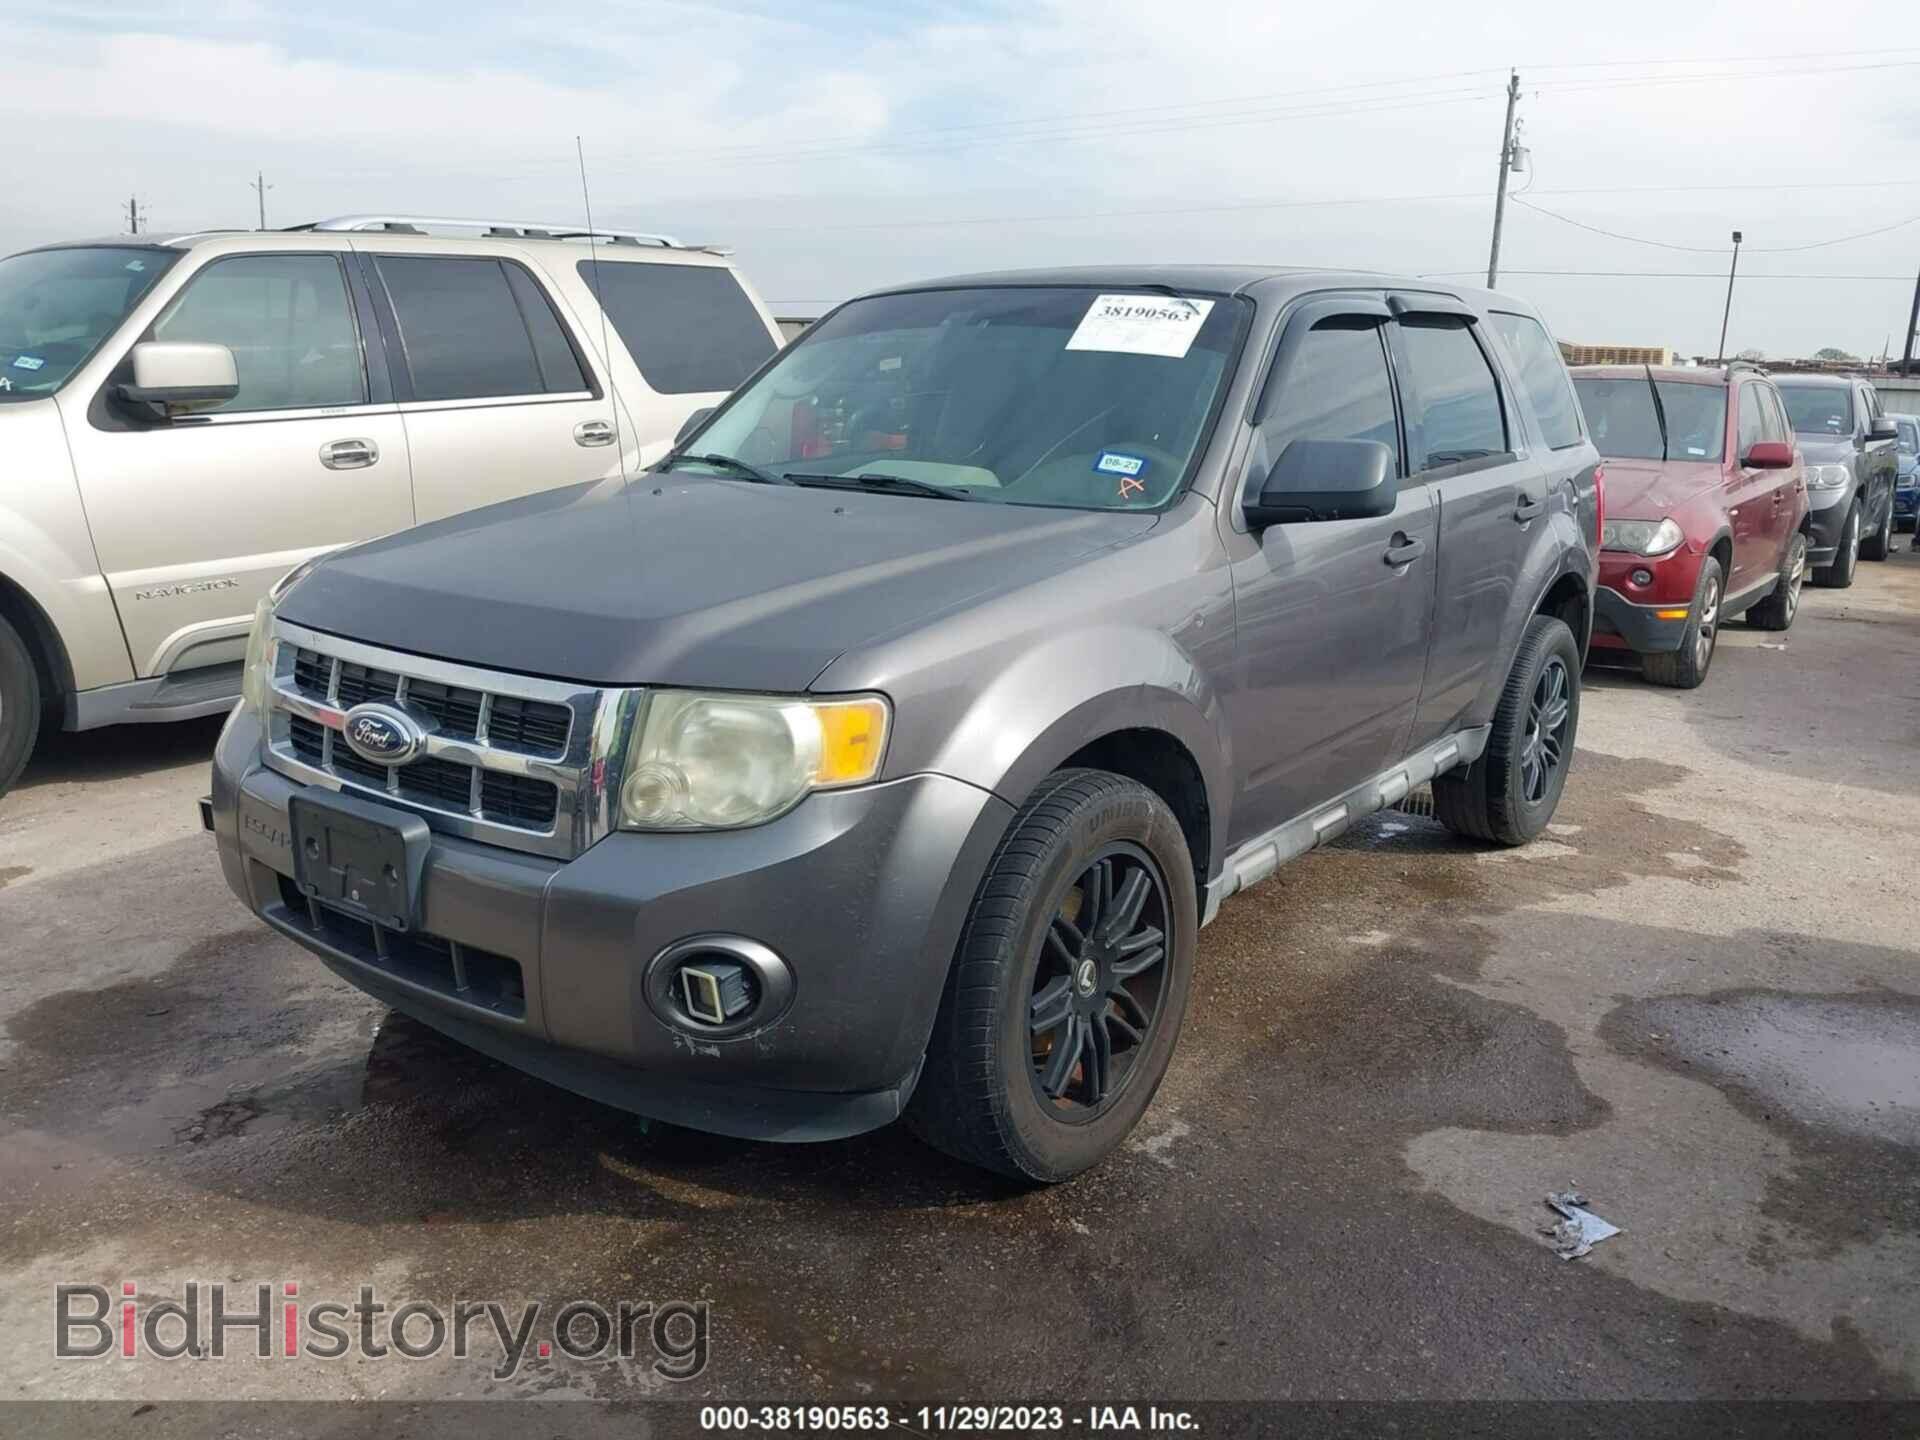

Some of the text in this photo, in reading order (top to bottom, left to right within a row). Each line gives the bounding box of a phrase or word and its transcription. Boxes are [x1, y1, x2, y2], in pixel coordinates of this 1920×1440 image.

[1097, 304, 1193, 322] 38190563
[135, 576, 240, 601] NAVIGATOR
[354, 718, 391, 748] Ford
[244, 812, 291, 849] ESCAP
